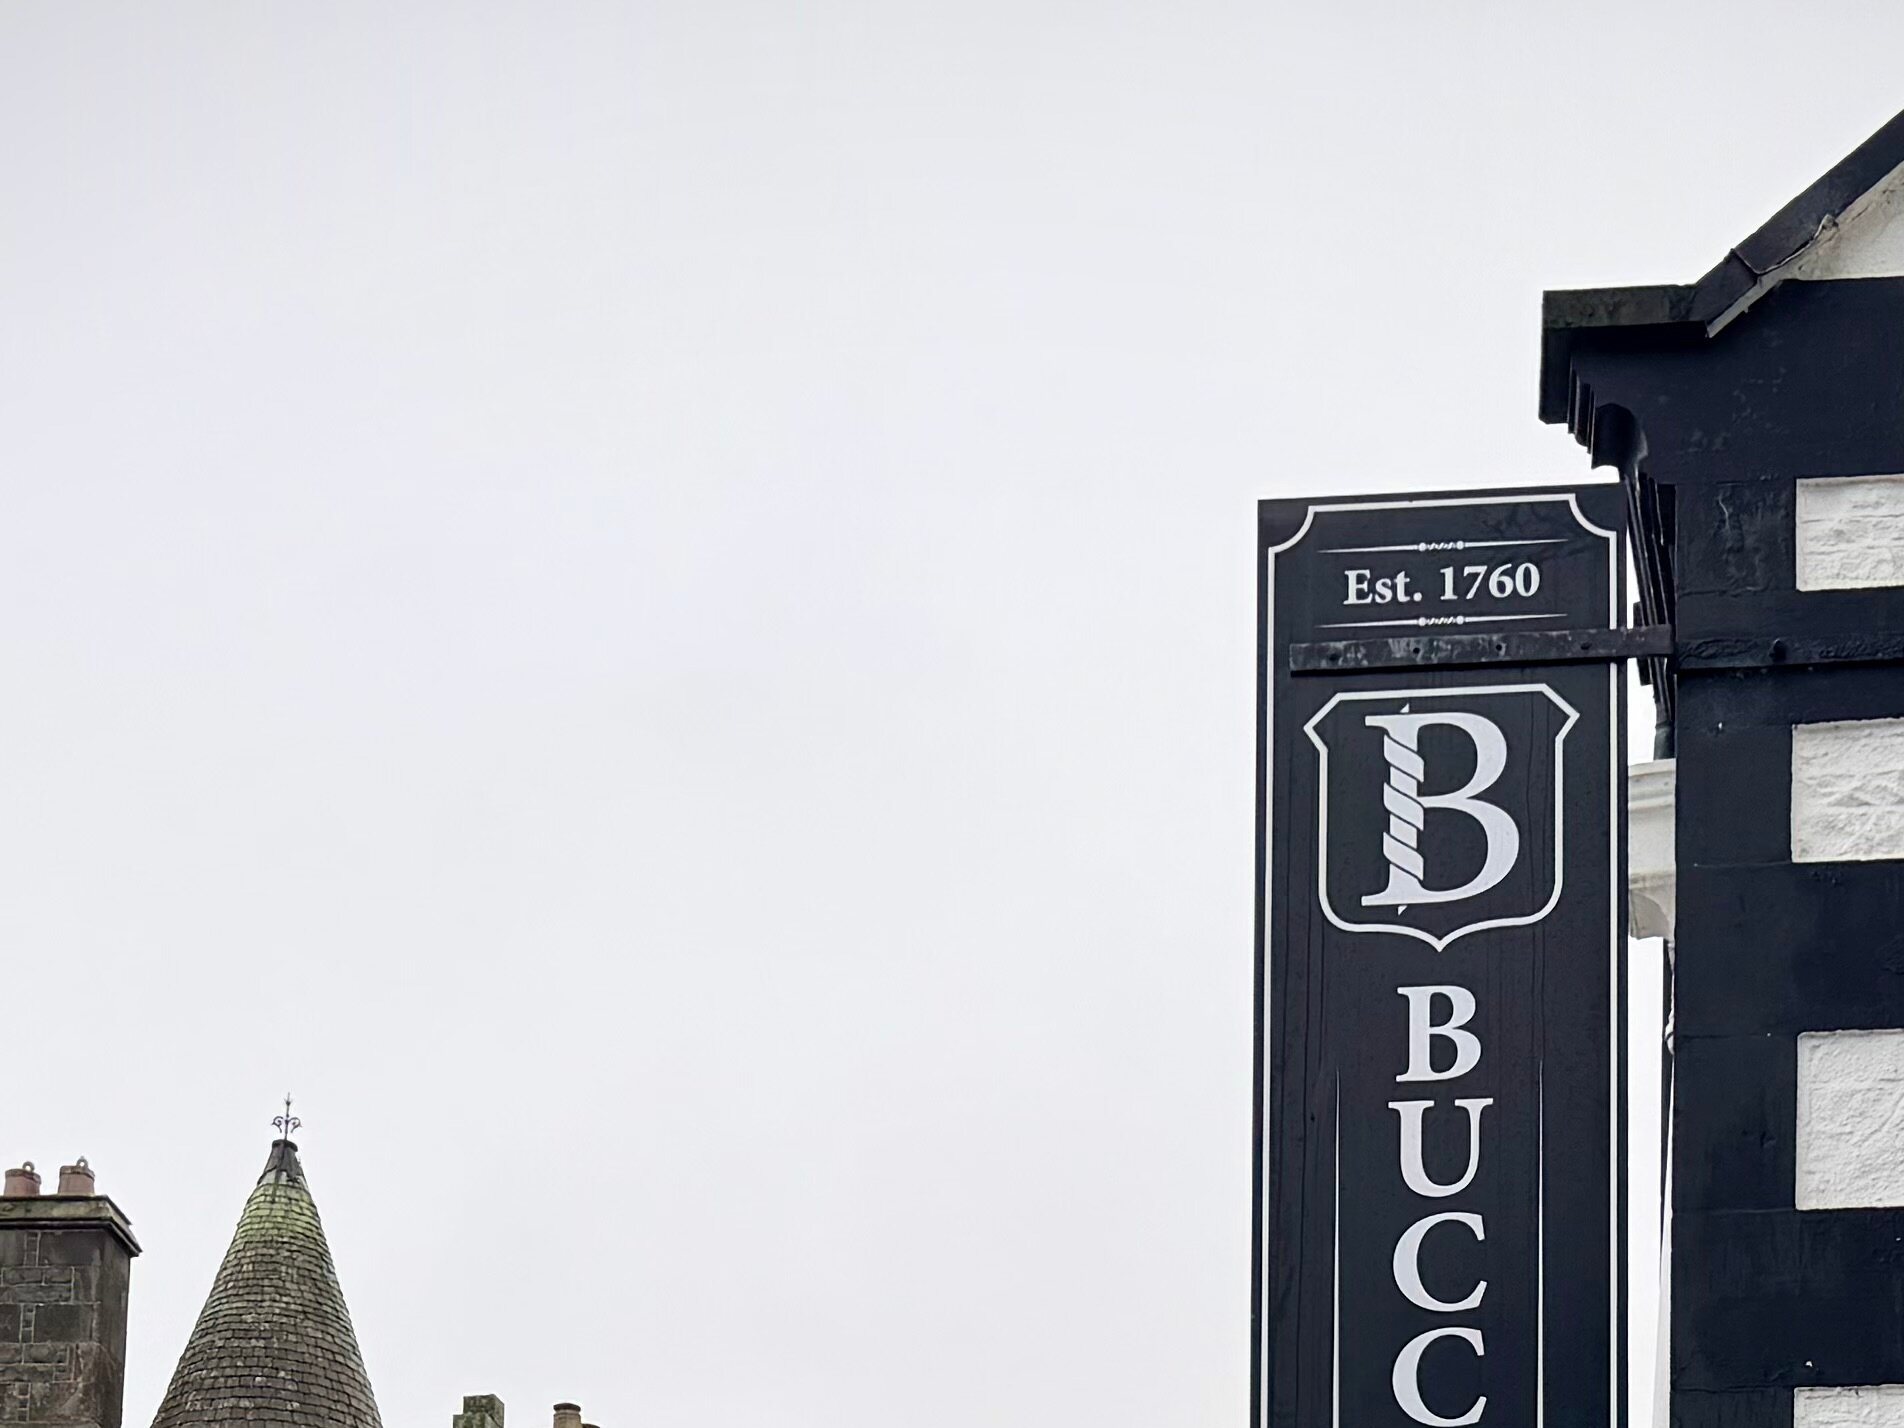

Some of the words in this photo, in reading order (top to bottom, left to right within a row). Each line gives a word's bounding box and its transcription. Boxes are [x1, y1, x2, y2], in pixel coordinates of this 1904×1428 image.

[1343, 567, 1424, 606] Est.
[1439, 562, 1540, 601] 1760
[1361, 703, 1520, 915] B
